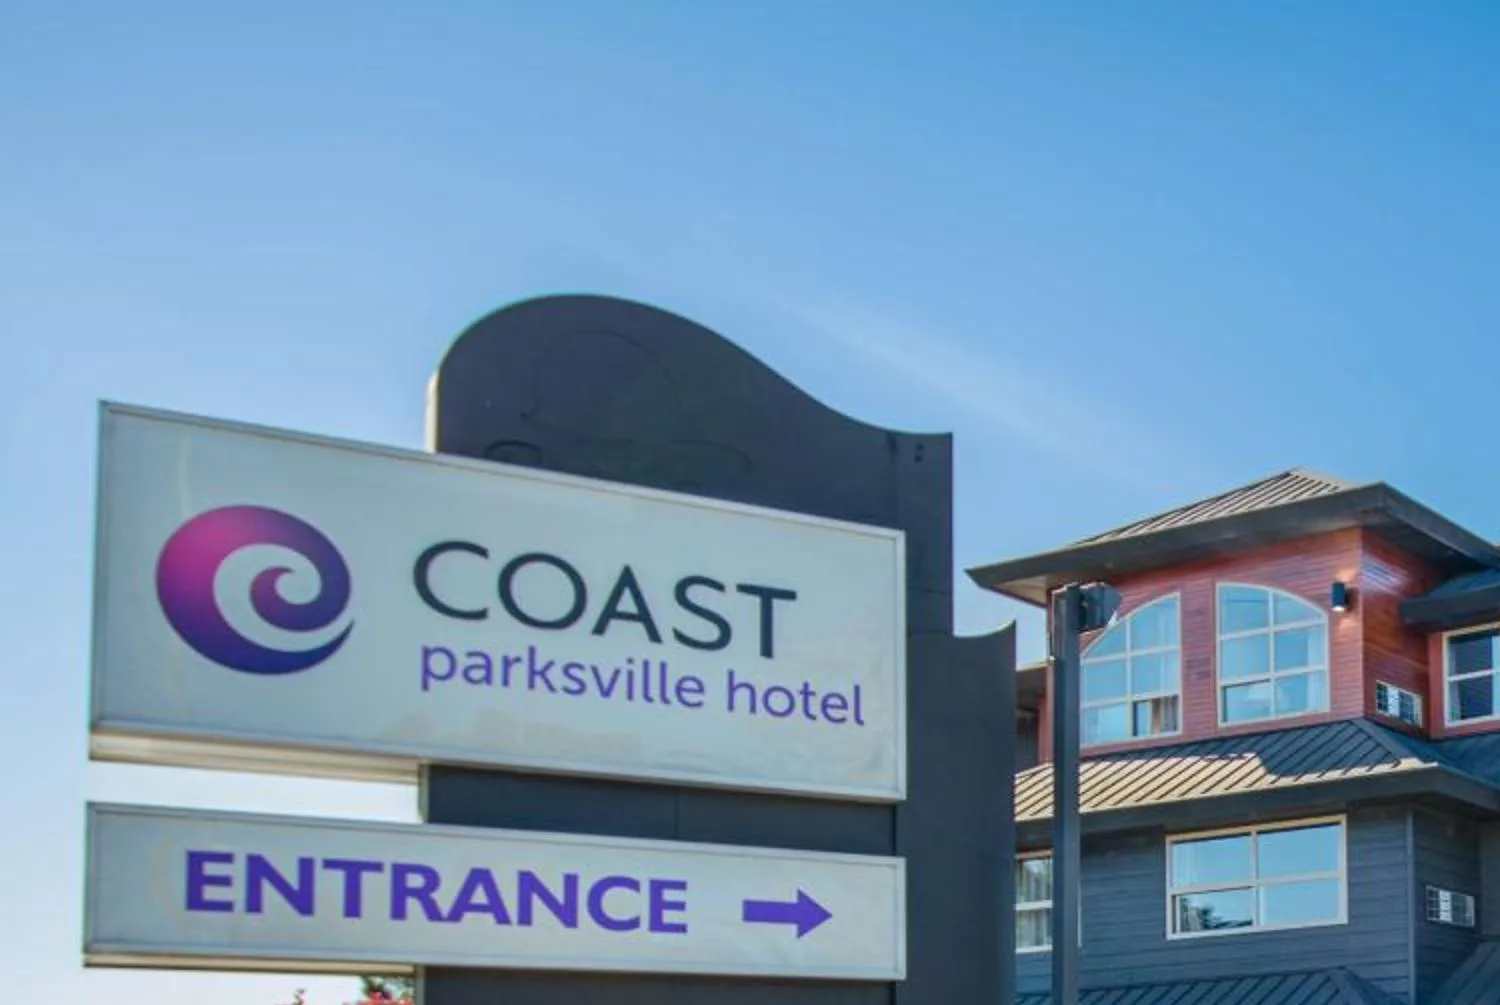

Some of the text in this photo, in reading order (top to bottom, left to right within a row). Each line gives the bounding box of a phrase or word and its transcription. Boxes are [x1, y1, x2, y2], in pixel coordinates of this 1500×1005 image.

[413, 541, 797, 659] COAST
[420, 643, 865, 727] parksville hotel
[184, 850, 689, 934] ENTRANCE
